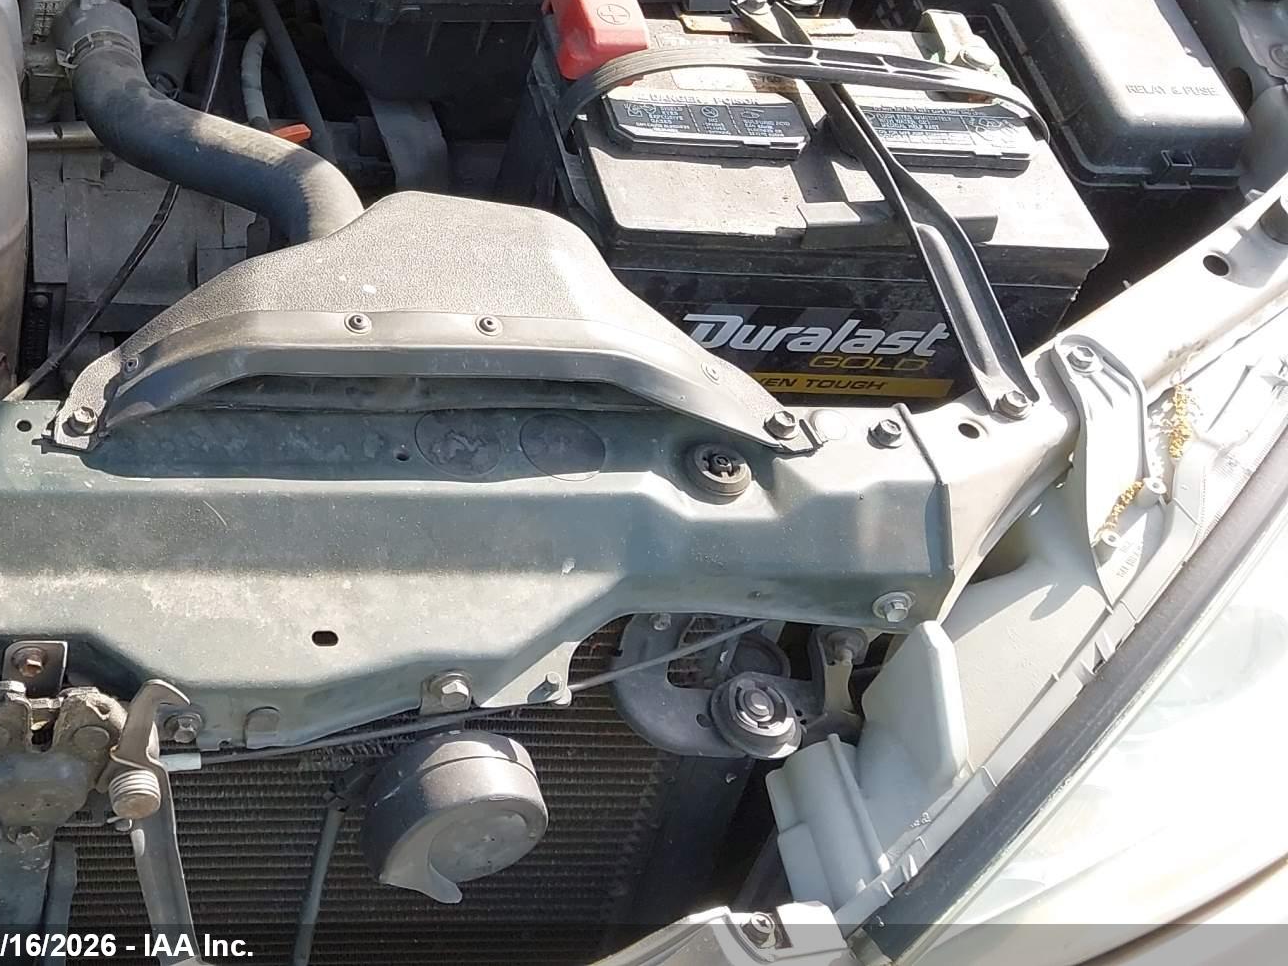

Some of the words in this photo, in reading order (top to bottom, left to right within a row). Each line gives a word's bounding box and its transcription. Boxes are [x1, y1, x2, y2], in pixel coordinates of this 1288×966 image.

[683, 313, 949, 356] Duralast
[808, 355, 926, 371] GOLD
[805, 378, 888, 391] TOUGH
